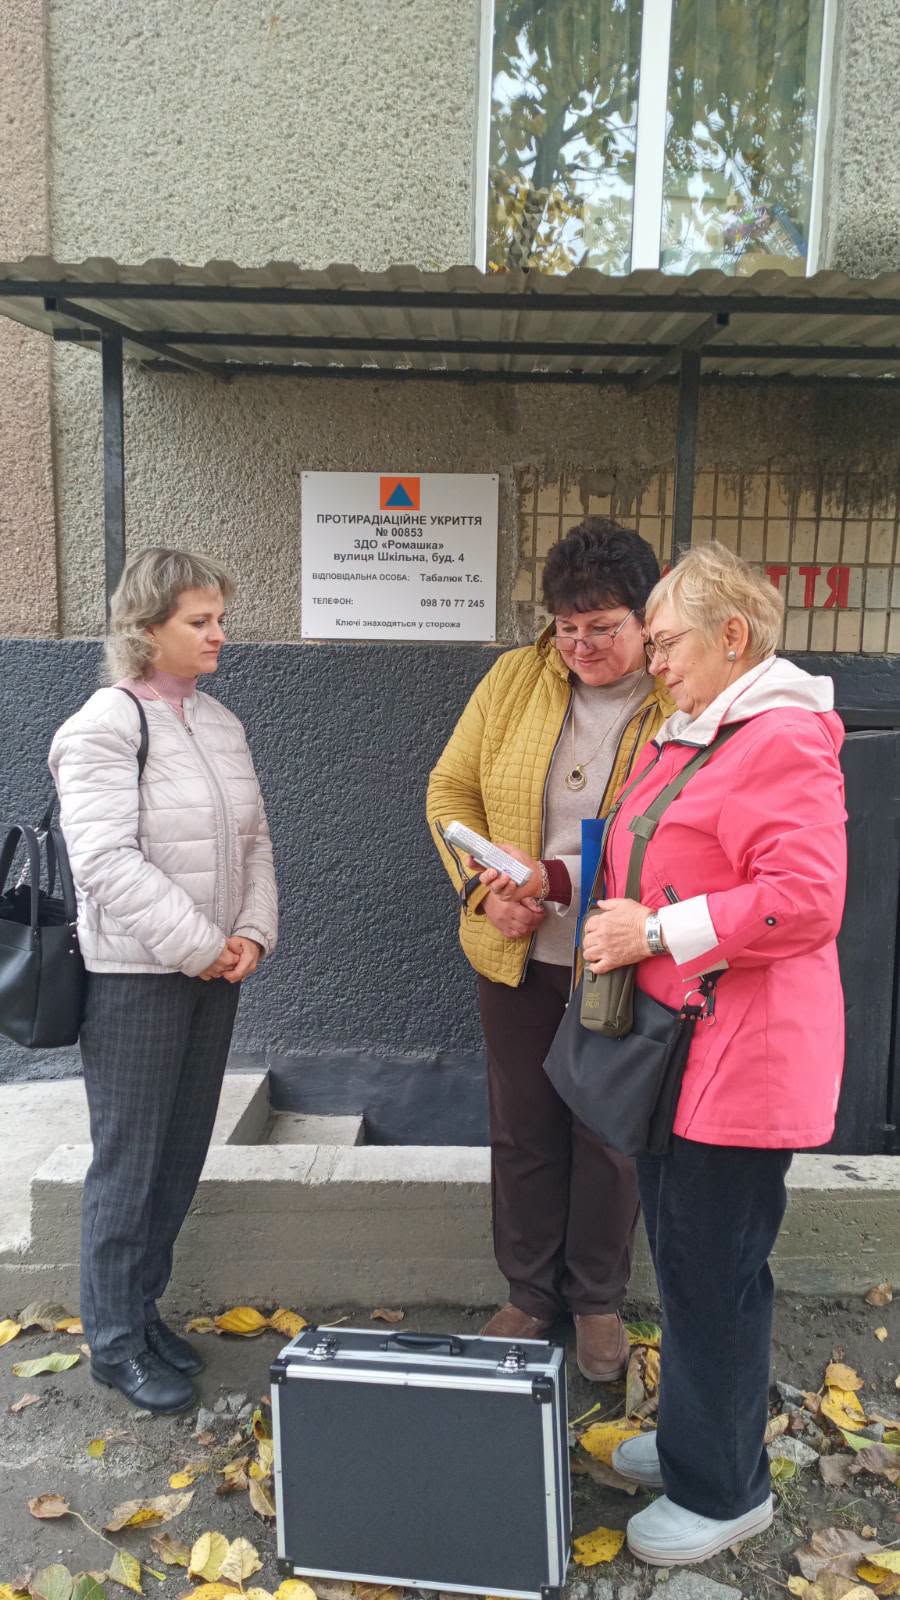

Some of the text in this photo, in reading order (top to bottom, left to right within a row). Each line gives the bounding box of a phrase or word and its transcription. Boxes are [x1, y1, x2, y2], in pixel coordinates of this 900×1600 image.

[317, 514, 482, 525] ПРОТИРАДІАЦІЙНЕ УКРИТТЯ
[375, 528, 423, 537] № 00853
[354, 540, 443, 550] ЗДО «Ромашка»
[334, 552, 464, 564] вулиця Шкільна, буд. 4
[313, 573, 377, 581] ВІДПОВІДАЛЬНА
[380, 573, 410, 581] ОСОБА:
[420, 573, 462, 583] Табалюк
[765, 565, 850, 608] ТТЯ
[421, 599, 437, 607] 098
[441, 599, 451, 607] 70
[454, 599, 465, 607] 77
[468, 600, 485, 608] 245
[336, 619, 361, 627] Ключі
[363, 620, 416, 628] знаходяться
